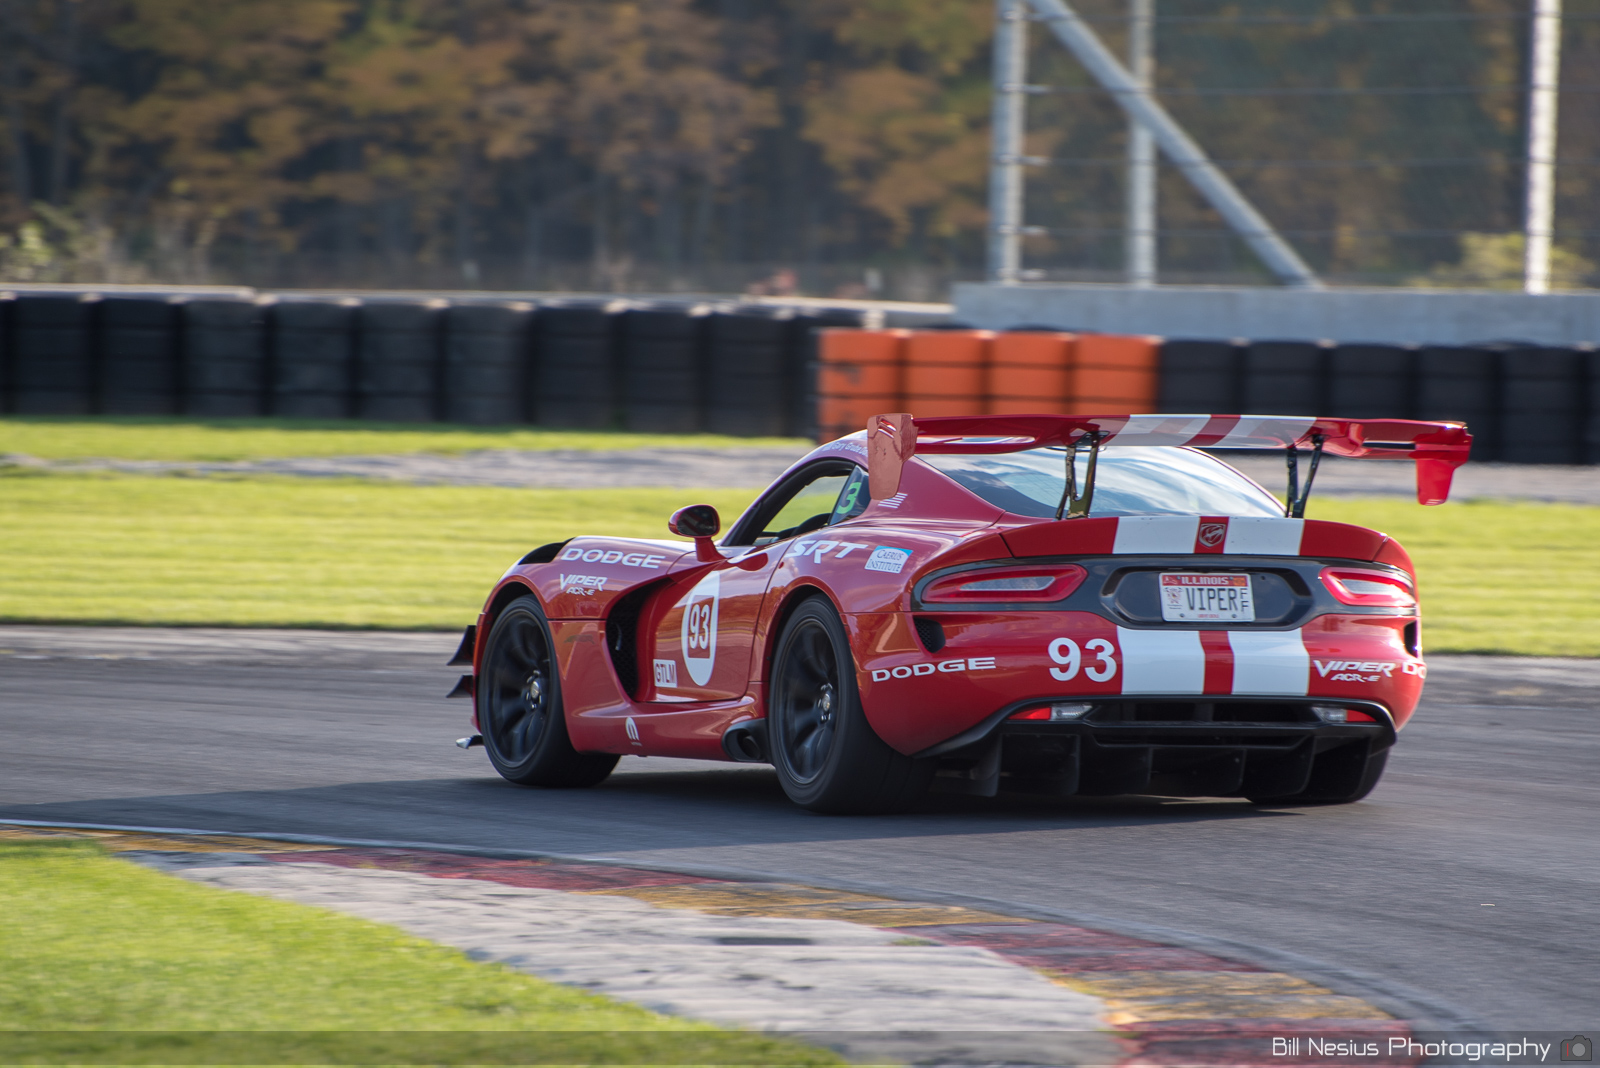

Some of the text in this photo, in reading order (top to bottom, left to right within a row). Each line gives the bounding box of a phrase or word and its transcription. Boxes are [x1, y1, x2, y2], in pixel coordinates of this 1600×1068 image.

[836, 481, 862, 514] 3
[560, 548, 666, 568] DODGE
[783, 540, 869, 564] SRT
[866, 558, 902, 572] INSTITUTE
[560, 573, 608, 591] VIPER
[1181, 576, 1229, 585] ILLINOIS
[566, 586, 595, 596] ACR-E
[1186, 587, 1238, 611] VIPER
[689, 604, 710, 650] 93
[871, 656, 996, 682] DODGE
[1048, 637, 1117, 682] 93
[1313, 660, 1396, 678] VIPER
[654, 663, 677, 684] GTLM
[1330, 673, 1381, 683] ACR-E
